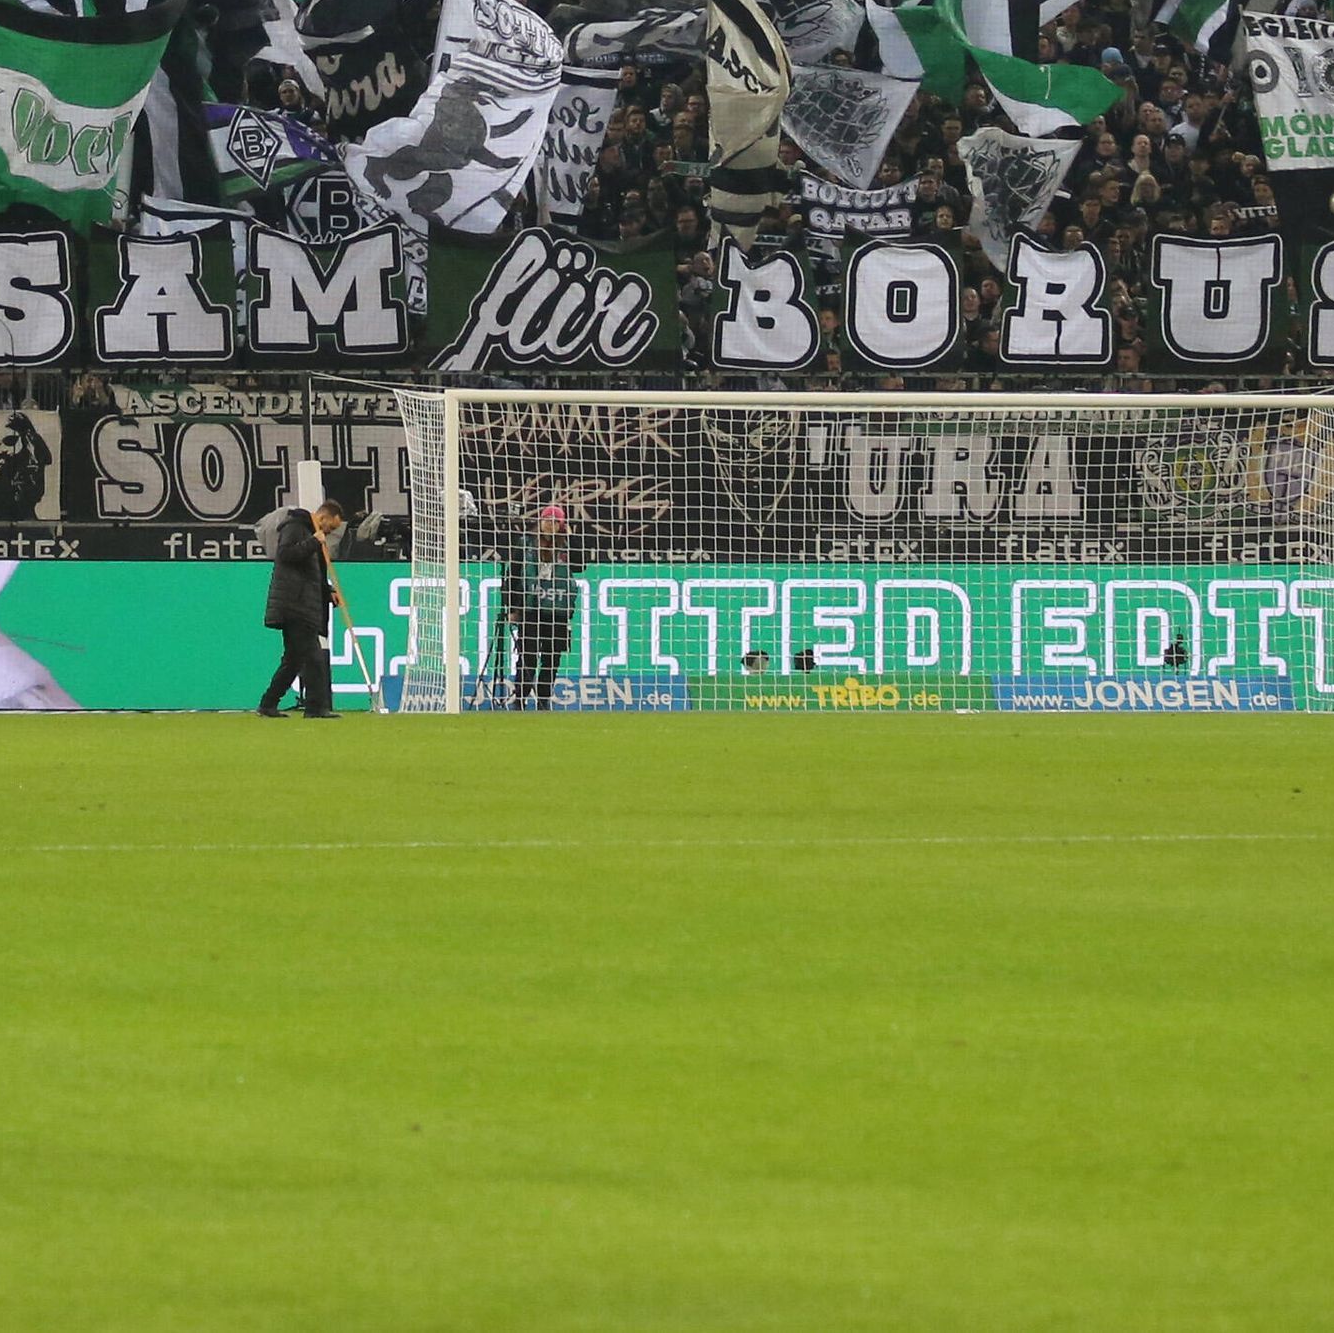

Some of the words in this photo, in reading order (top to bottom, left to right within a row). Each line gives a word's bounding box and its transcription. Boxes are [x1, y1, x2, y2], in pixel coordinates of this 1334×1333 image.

[800, 174, 920, 210] BOYCOTT
[807, 206, 913, 232] QATAR
[427, 224, 661, 371] für
[999, 534, 1126, 562] flatex
[297, 578, 971, 693] LIITED
[466, 677, 634, 706] JOGEN
[1074, 678, 1239, 708] JONGEN
